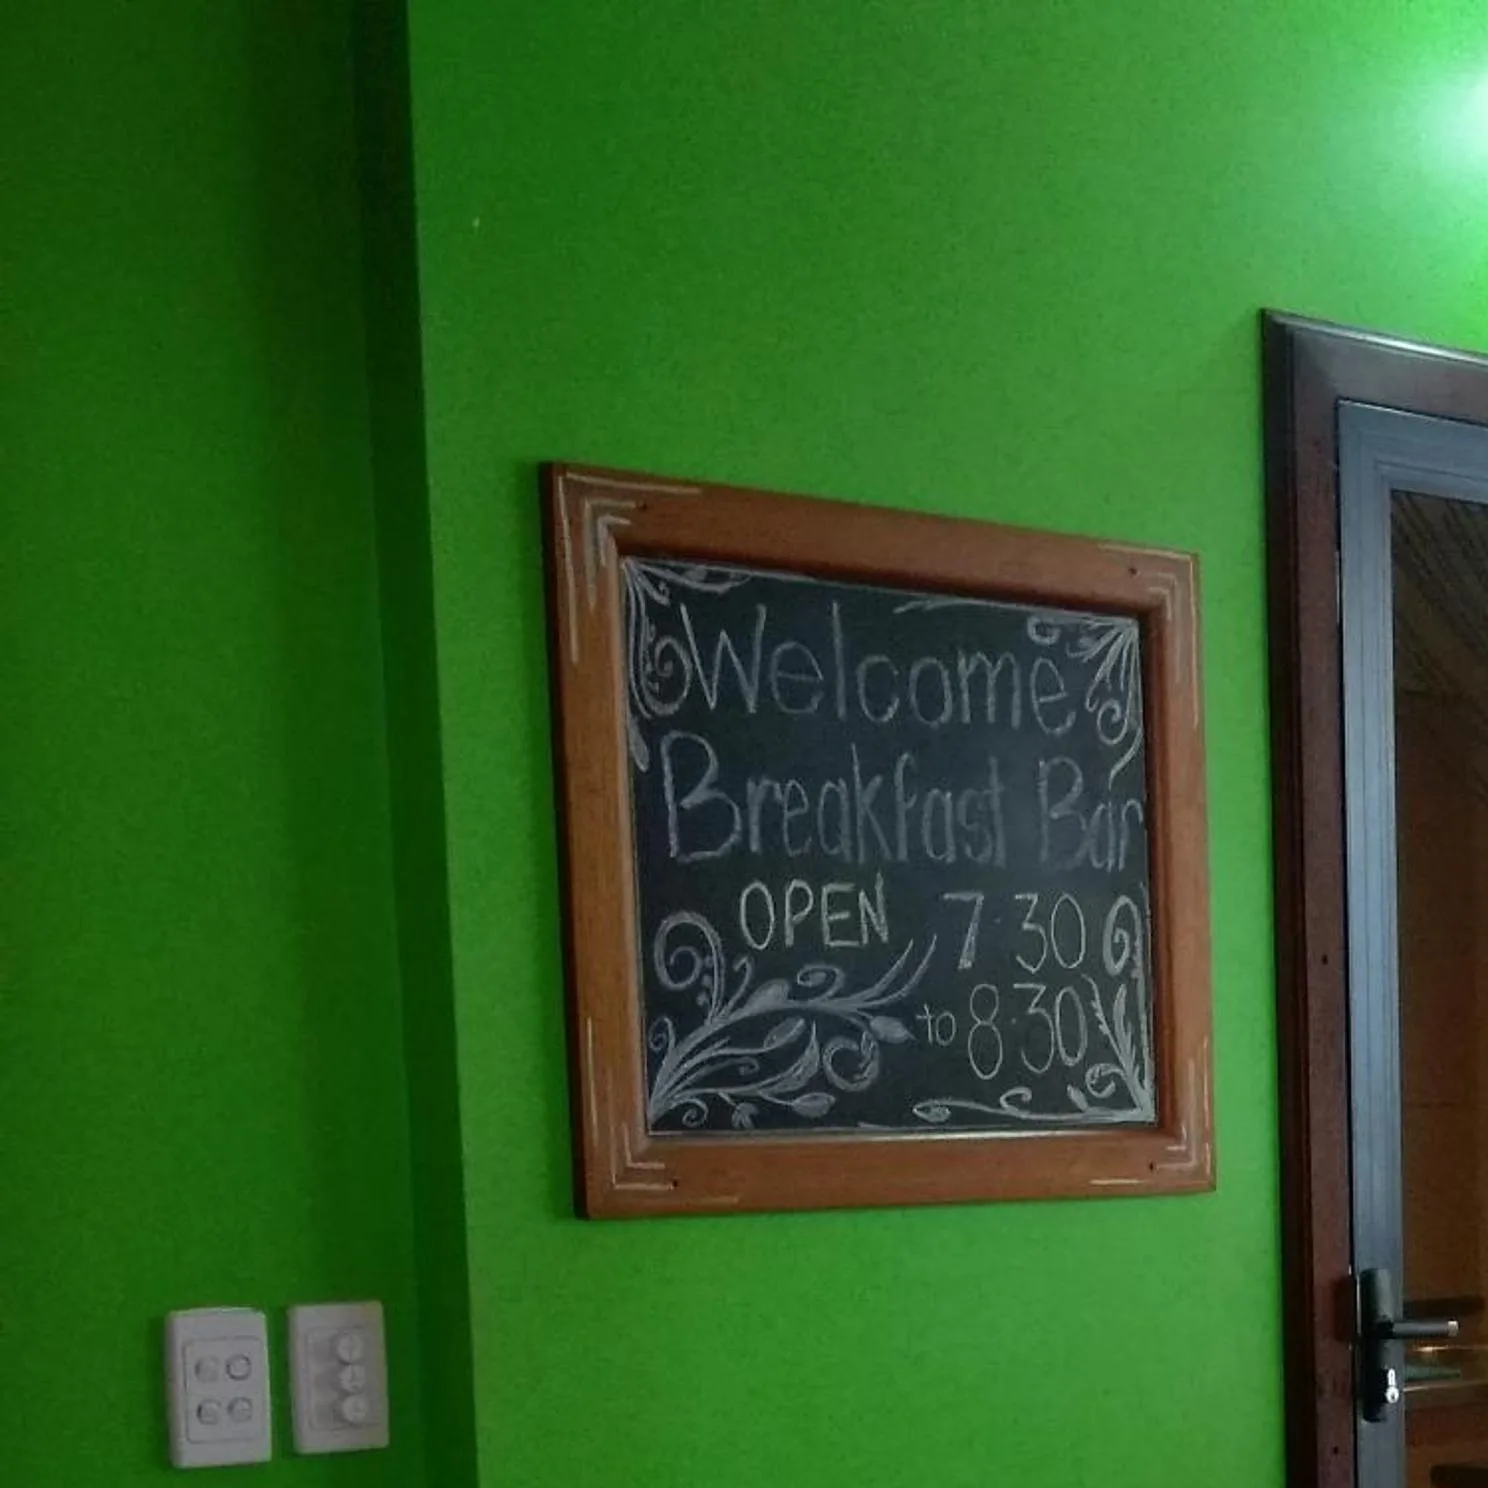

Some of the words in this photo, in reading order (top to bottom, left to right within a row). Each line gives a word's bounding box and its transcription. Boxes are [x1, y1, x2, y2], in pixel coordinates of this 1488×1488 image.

[680, 600, 1077, 734] Welcome
[660, 729, 1005, 868] Breakfast
[1037, 756, 1144, 873] Bar
[738, 872, 890, 951] OPEN
[915, 1003, 957, 1046] to
